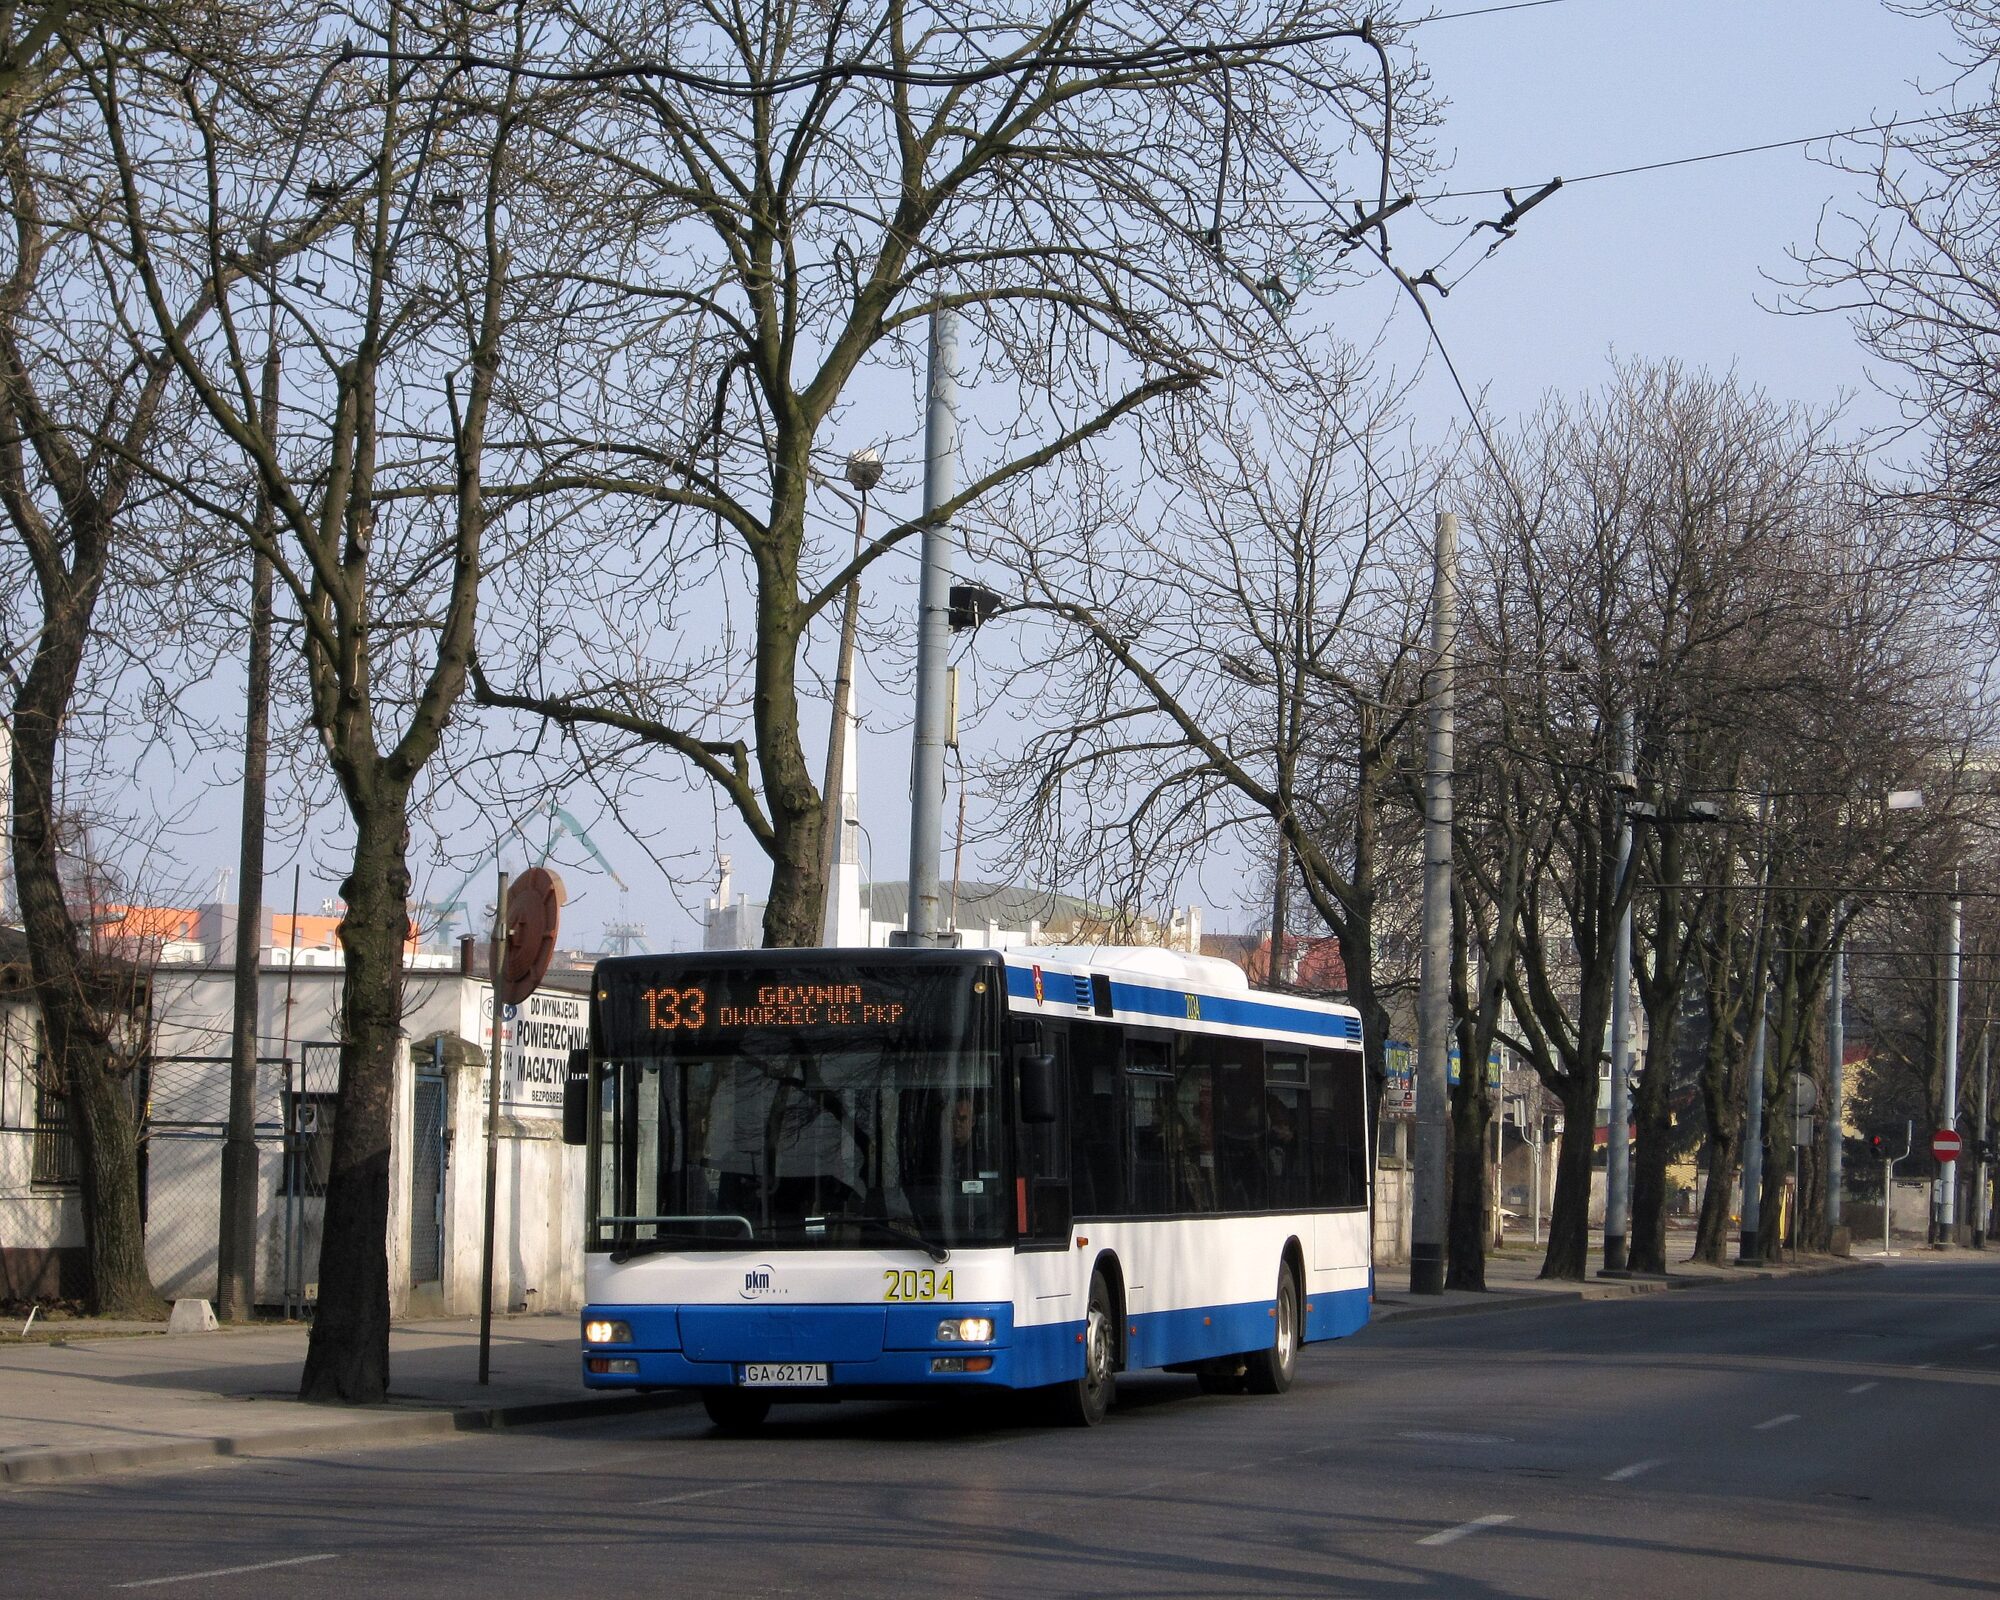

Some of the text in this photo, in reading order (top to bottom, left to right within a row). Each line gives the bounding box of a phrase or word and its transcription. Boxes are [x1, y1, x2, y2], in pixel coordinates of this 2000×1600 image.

[758, 985, 862, 1005] GDYNIA
[530, 997, 541, 1015] DO
[641, 988, 705, 1029] 133
[720, 1007, 818, 1025] DWORZEC
[863, 1004, 903, 1023] PKP
[516, 1020, 590, 1050] POWIERZCHNIA
[745, 1270, 770, 1290] pkm
[883, 1269, 954, 1301] 2034
[748, 1365, 824, 1381] GA 6217L
